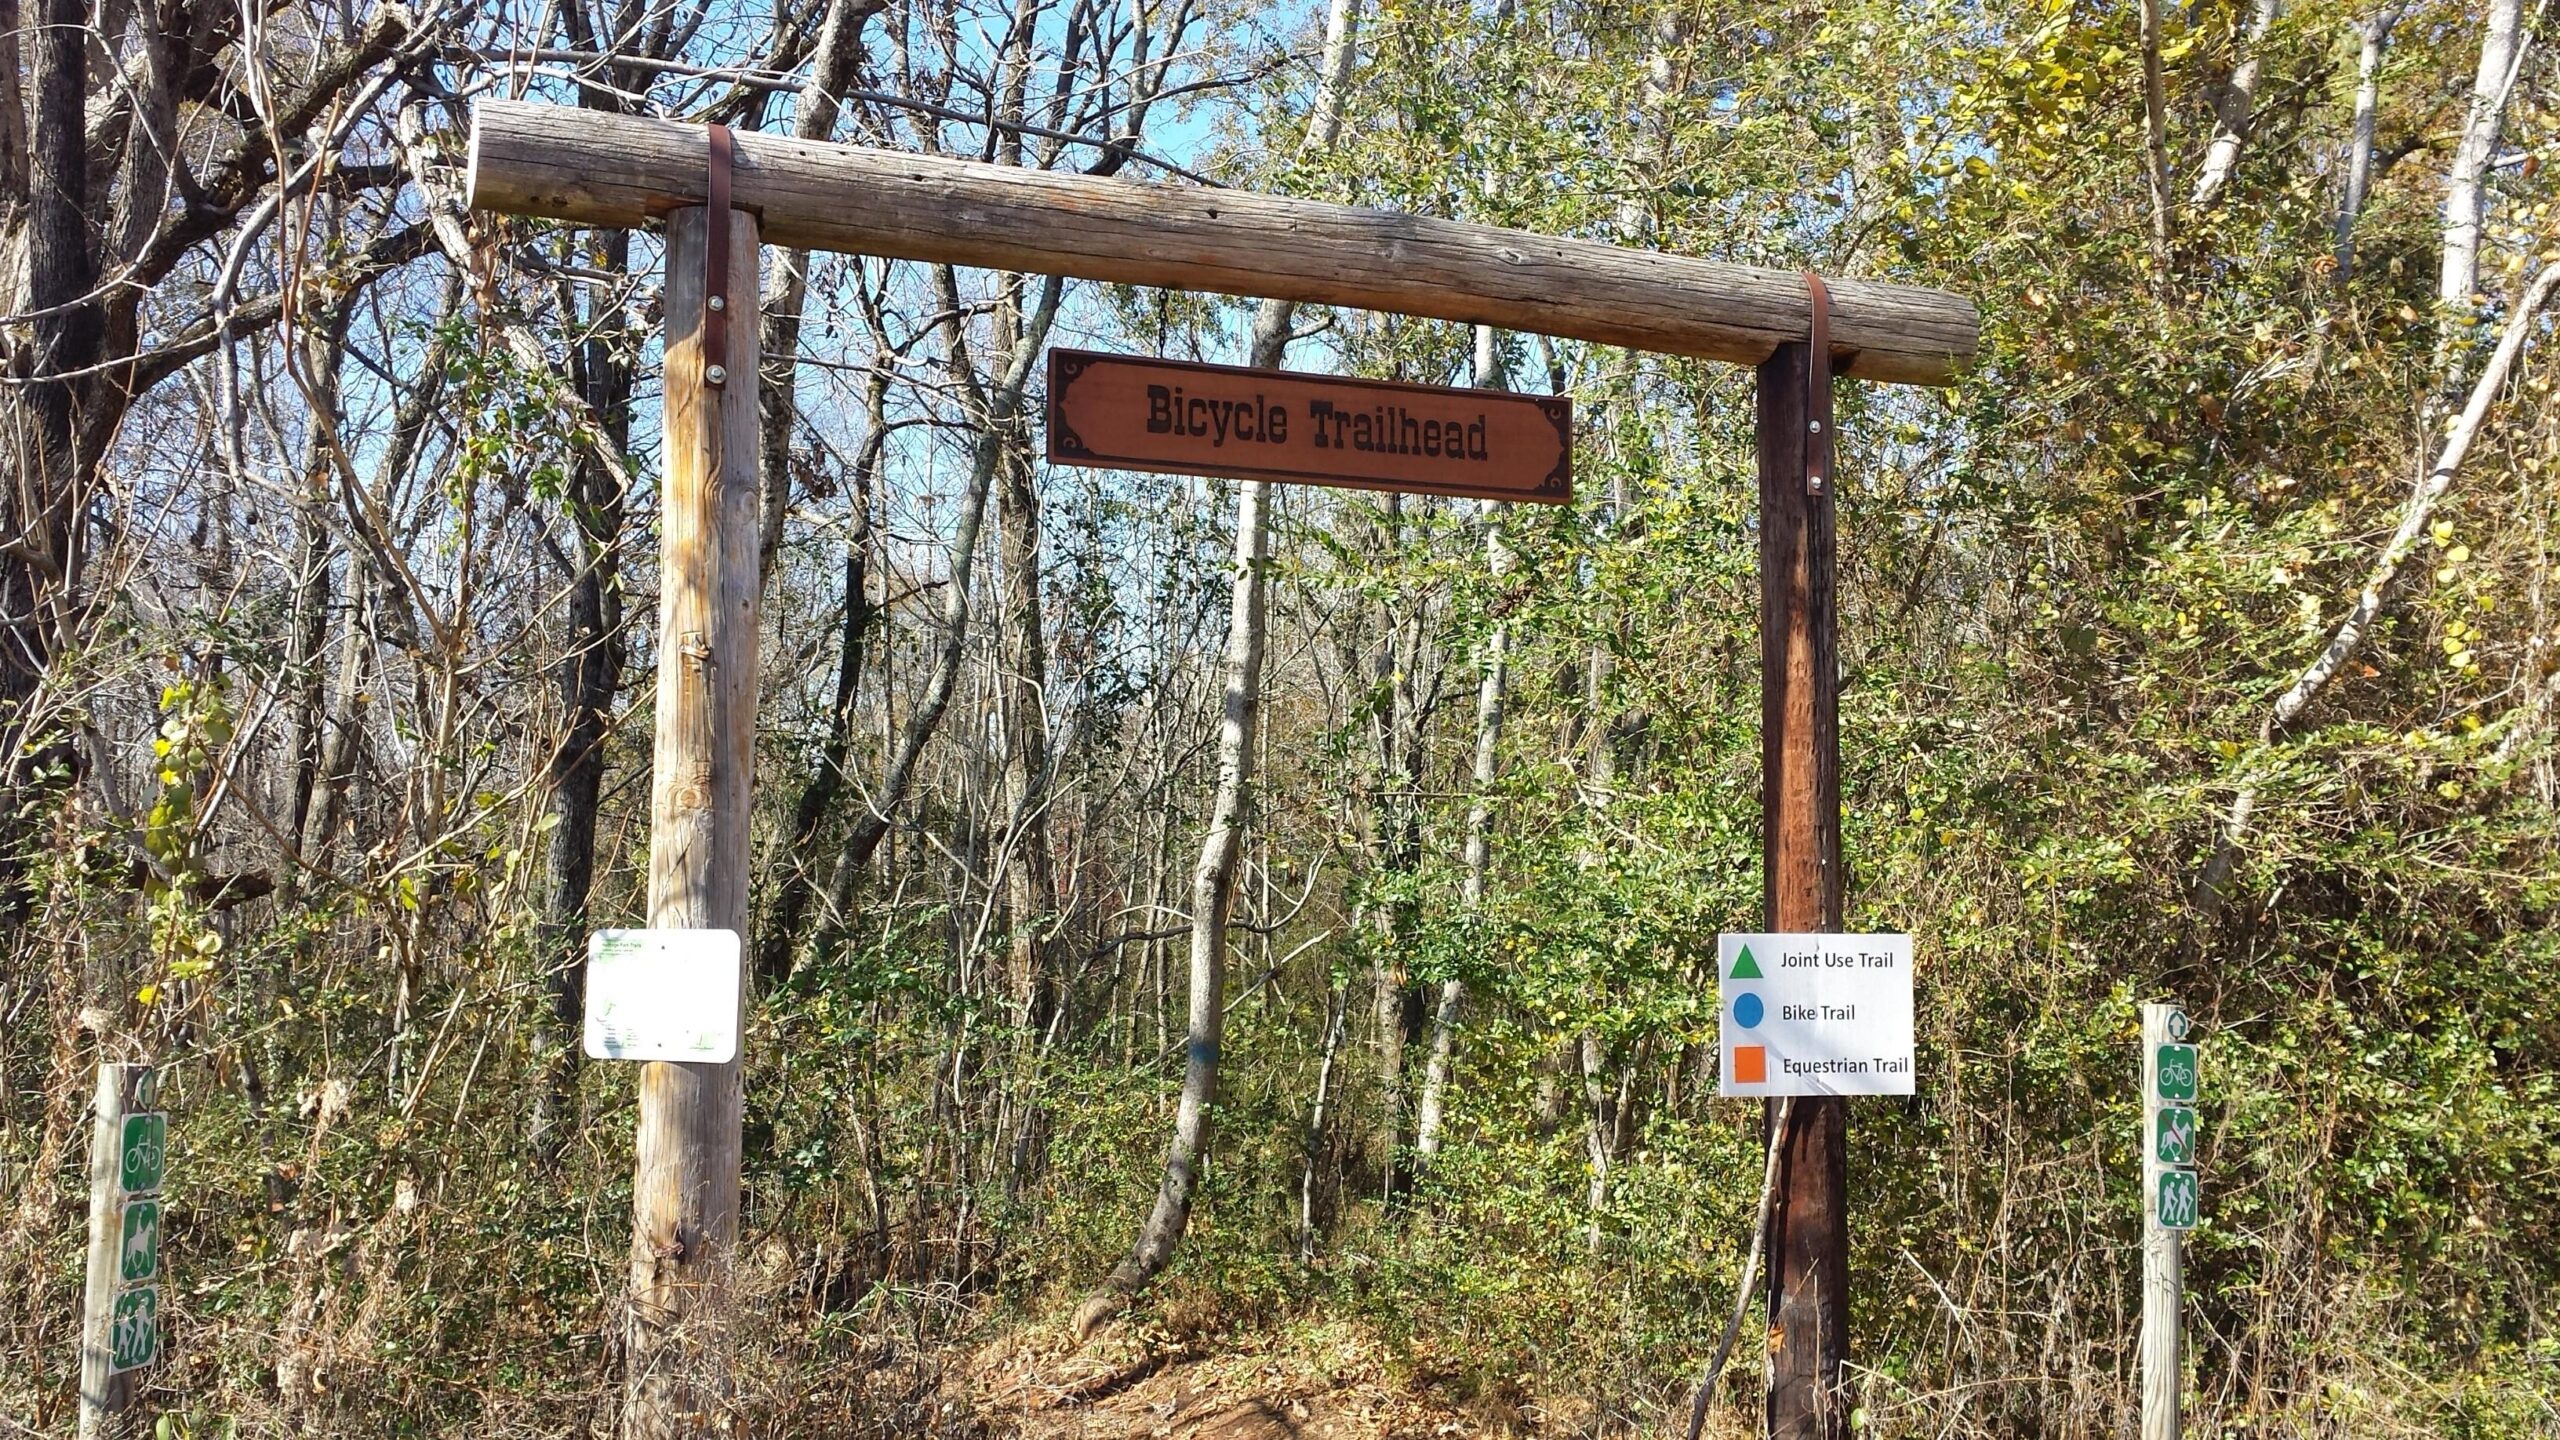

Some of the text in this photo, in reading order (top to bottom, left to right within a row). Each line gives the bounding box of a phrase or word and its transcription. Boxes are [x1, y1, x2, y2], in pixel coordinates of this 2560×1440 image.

[1146, 384, 1487, 461] Bicycle Trailhead
[1781, 952, 1893, 968] Joint Use Trail
[1783, 1005, 1855, 1020] Bike Trail
[1783, 1057, 1908, 1077] Equestrian Trail
